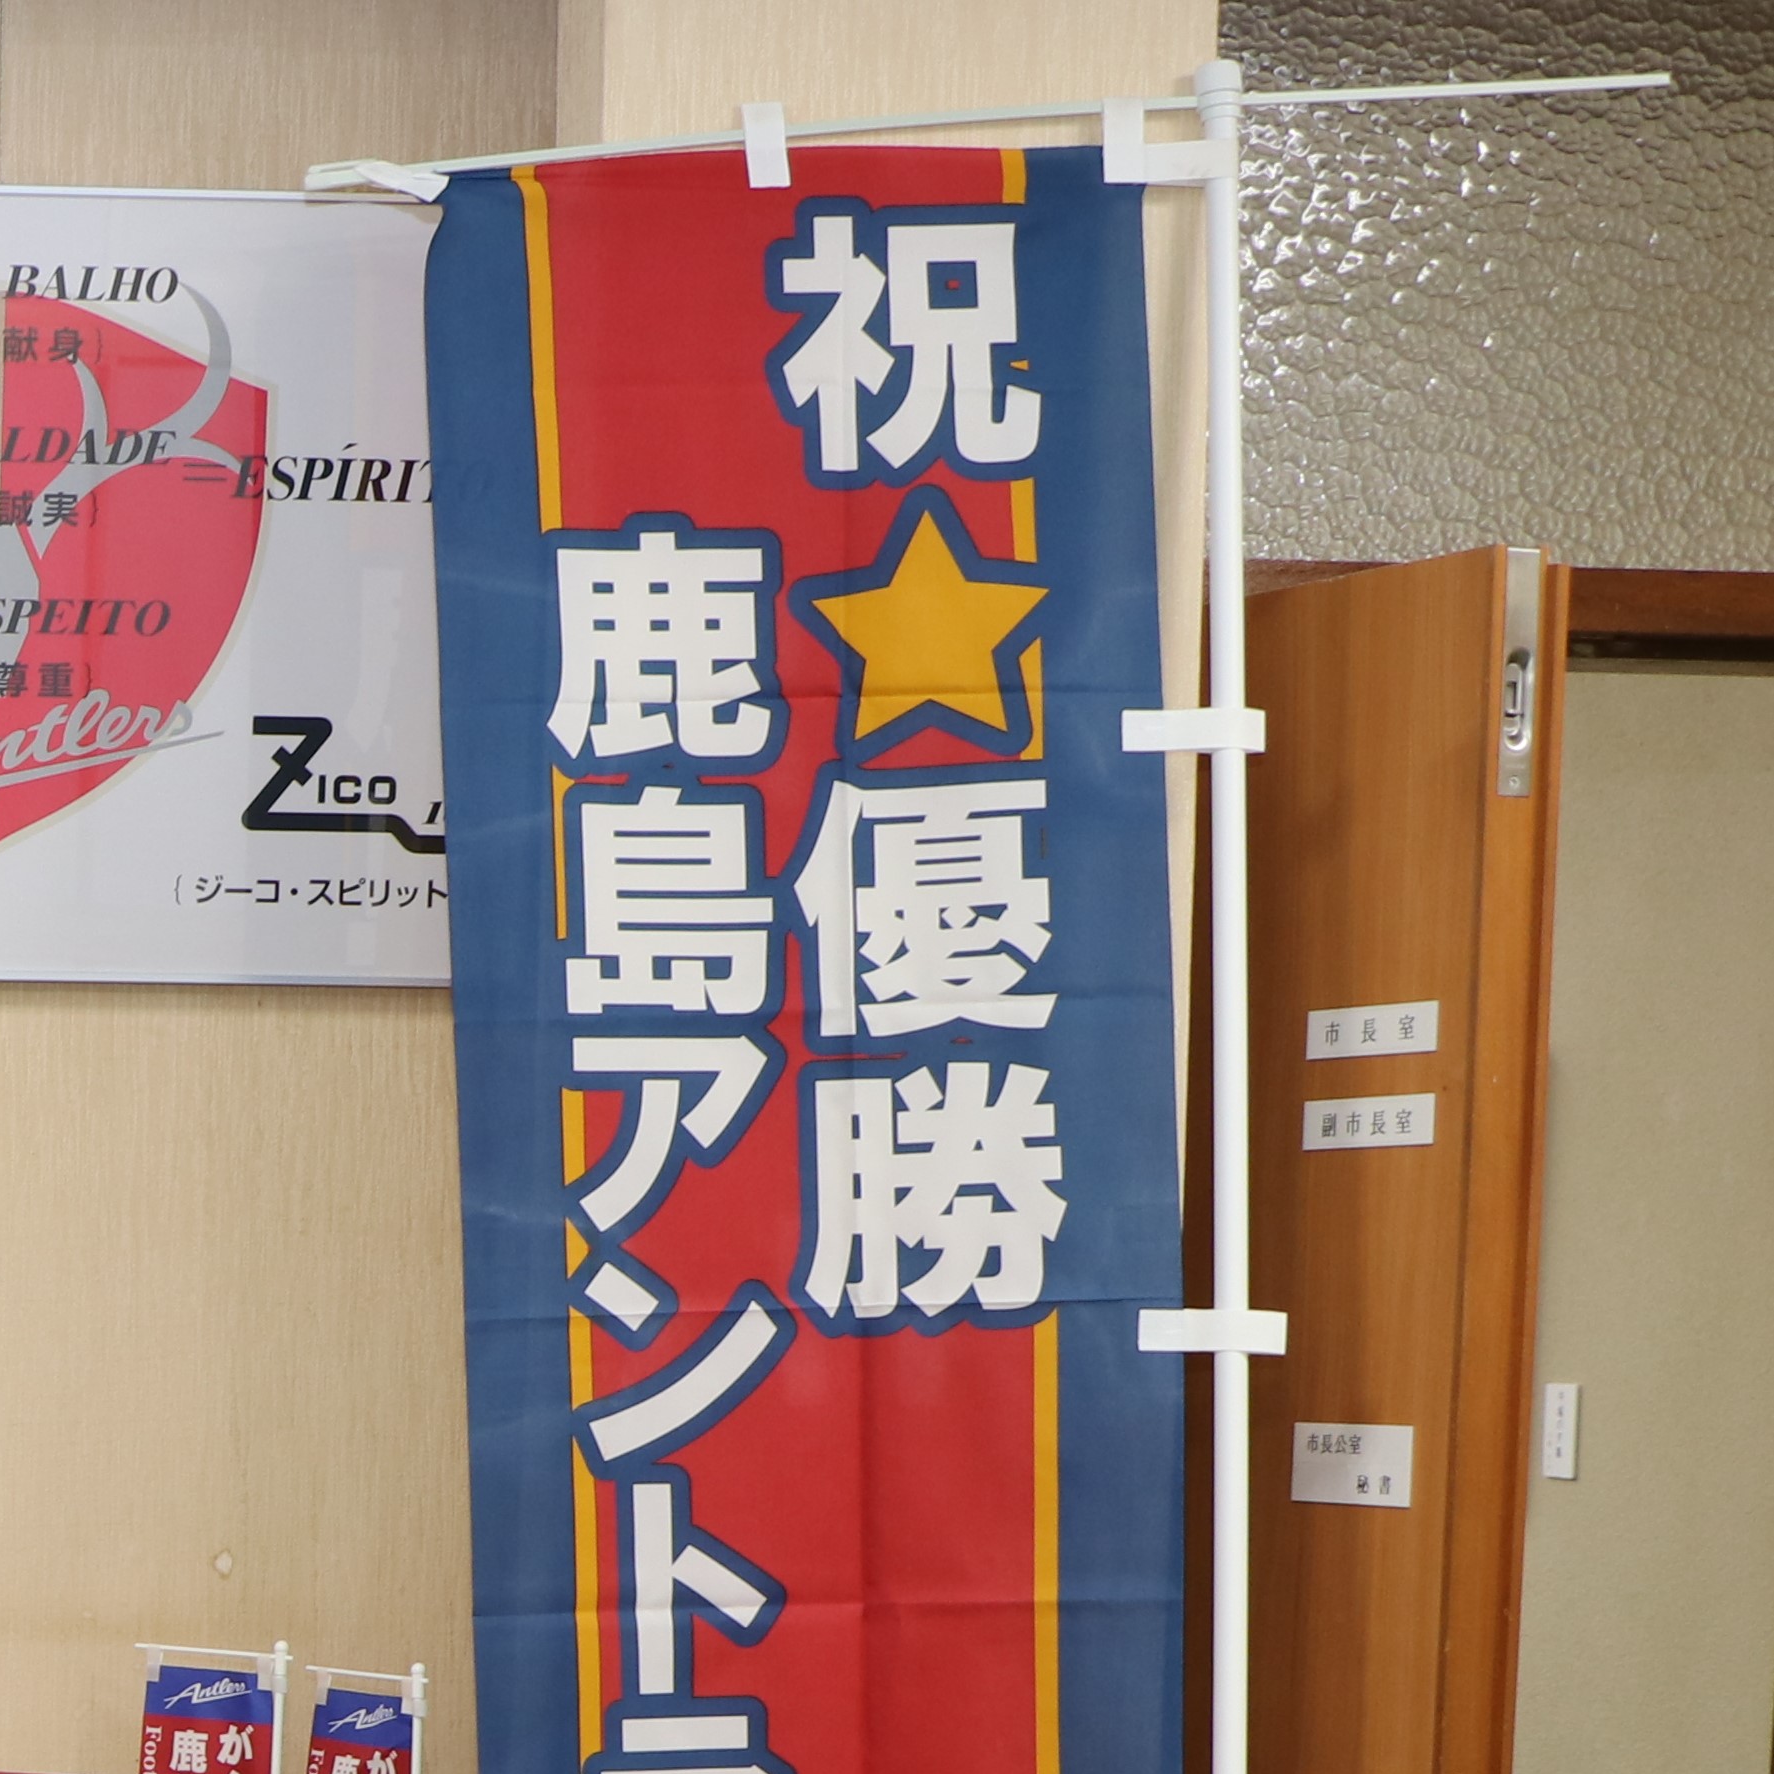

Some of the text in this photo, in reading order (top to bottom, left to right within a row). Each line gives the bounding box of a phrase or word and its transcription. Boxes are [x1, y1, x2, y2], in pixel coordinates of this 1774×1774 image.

[1325, 1015, 1415, 1046] 市長室
[1321, 1108, 1413, 1138] 副市長室
[1307, 1434, 1362, 1455] 市長公室
[1356, 1475, 1391, 1495] 秘書
[164, 1679, 253, 1709] Antlers
[328, 1703, 398, 1732] Antlers
